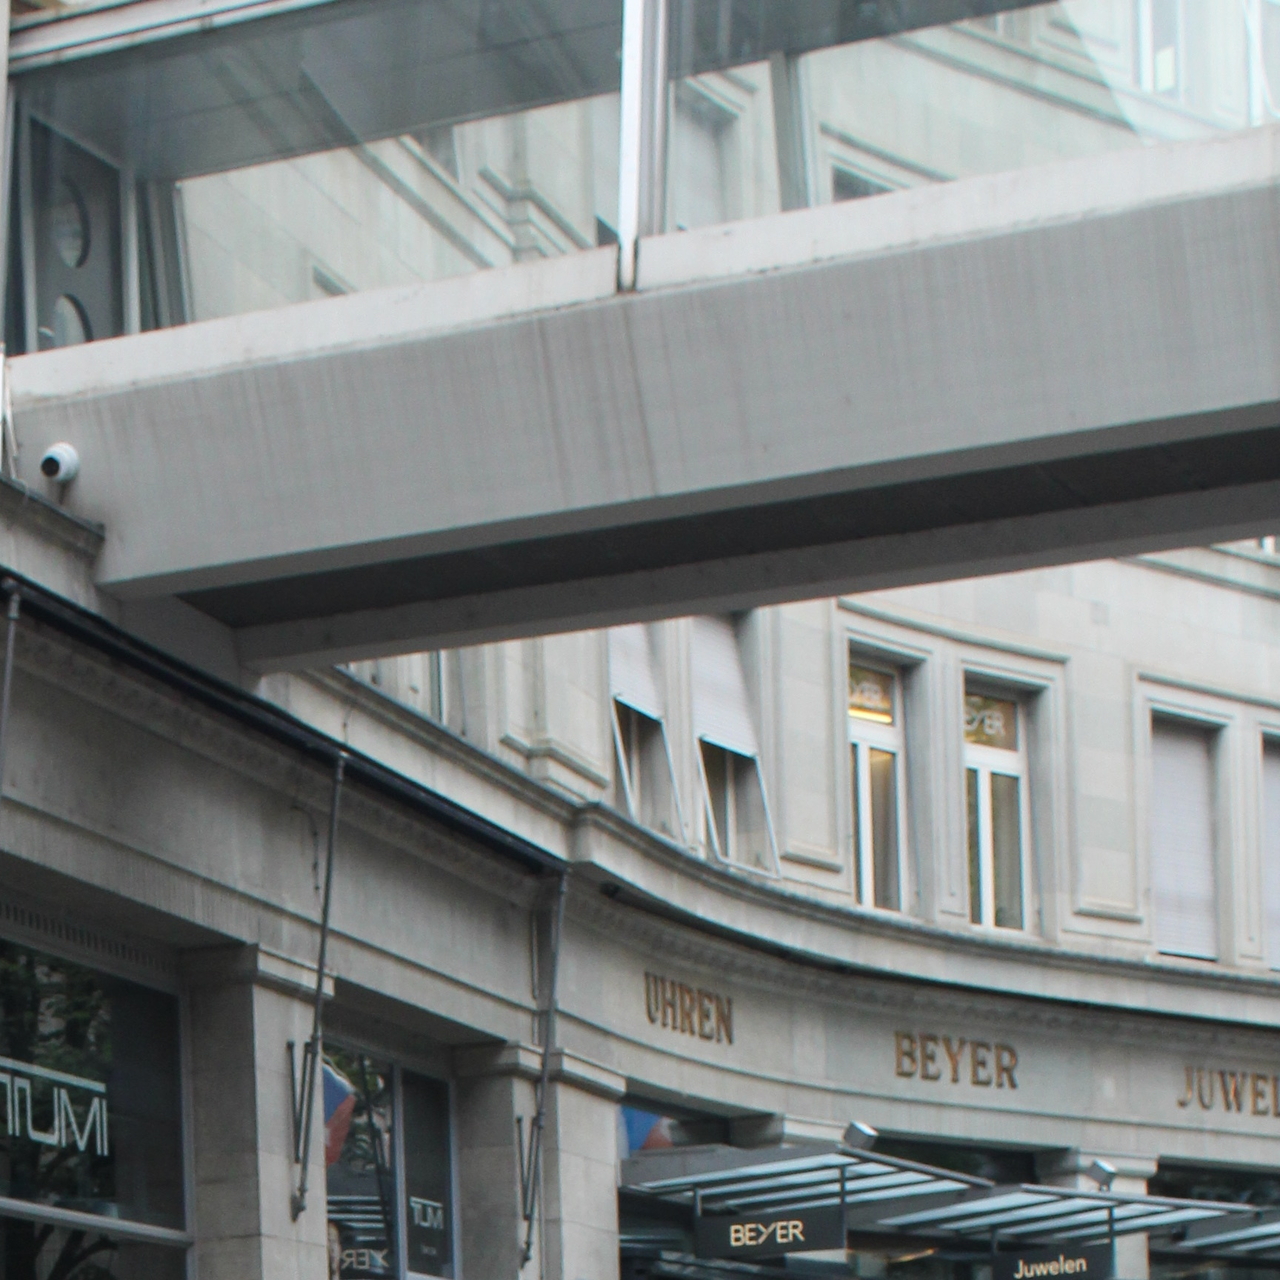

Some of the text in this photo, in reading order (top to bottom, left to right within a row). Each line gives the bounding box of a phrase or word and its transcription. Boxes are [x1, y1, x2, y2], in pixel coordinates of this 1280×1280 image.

[644, 971, 734, 1046] UHREN
[894, 1030, 1018, 1090] BEYER
[729, 1220, 805, 1247] BEYER
[1013, 1254, 1087, 1280] Juwelen
